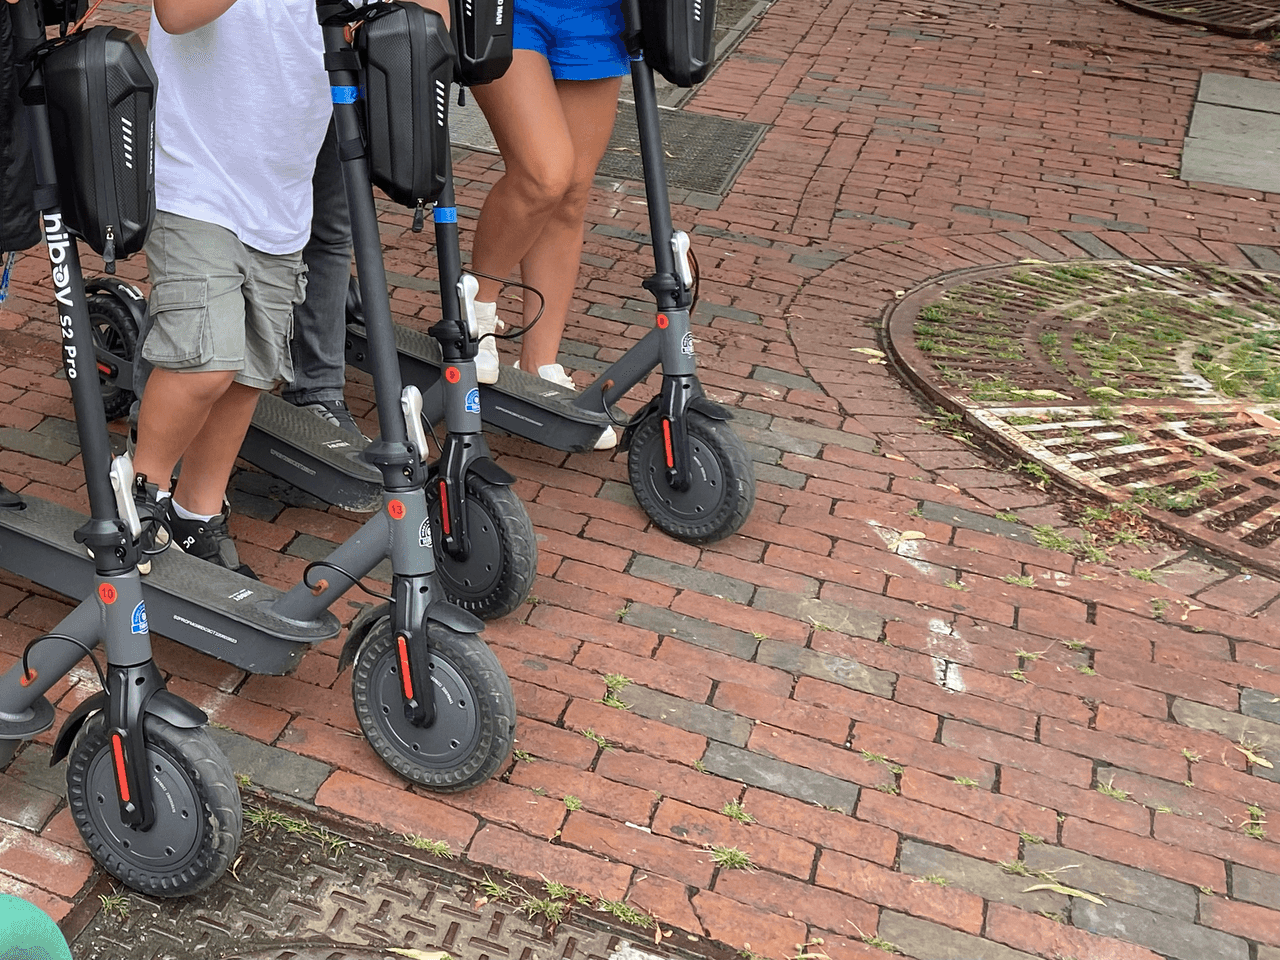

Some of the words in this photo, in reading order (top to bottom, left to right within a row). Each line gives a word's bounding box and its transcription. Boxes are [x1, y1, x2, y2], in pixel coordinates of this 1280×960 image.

[495, 5, 504, 26] MAN
[59, 314, 74, 339] S2
[64, 345, 77, 379] Pro
[101, 587, 114, 600] 10
